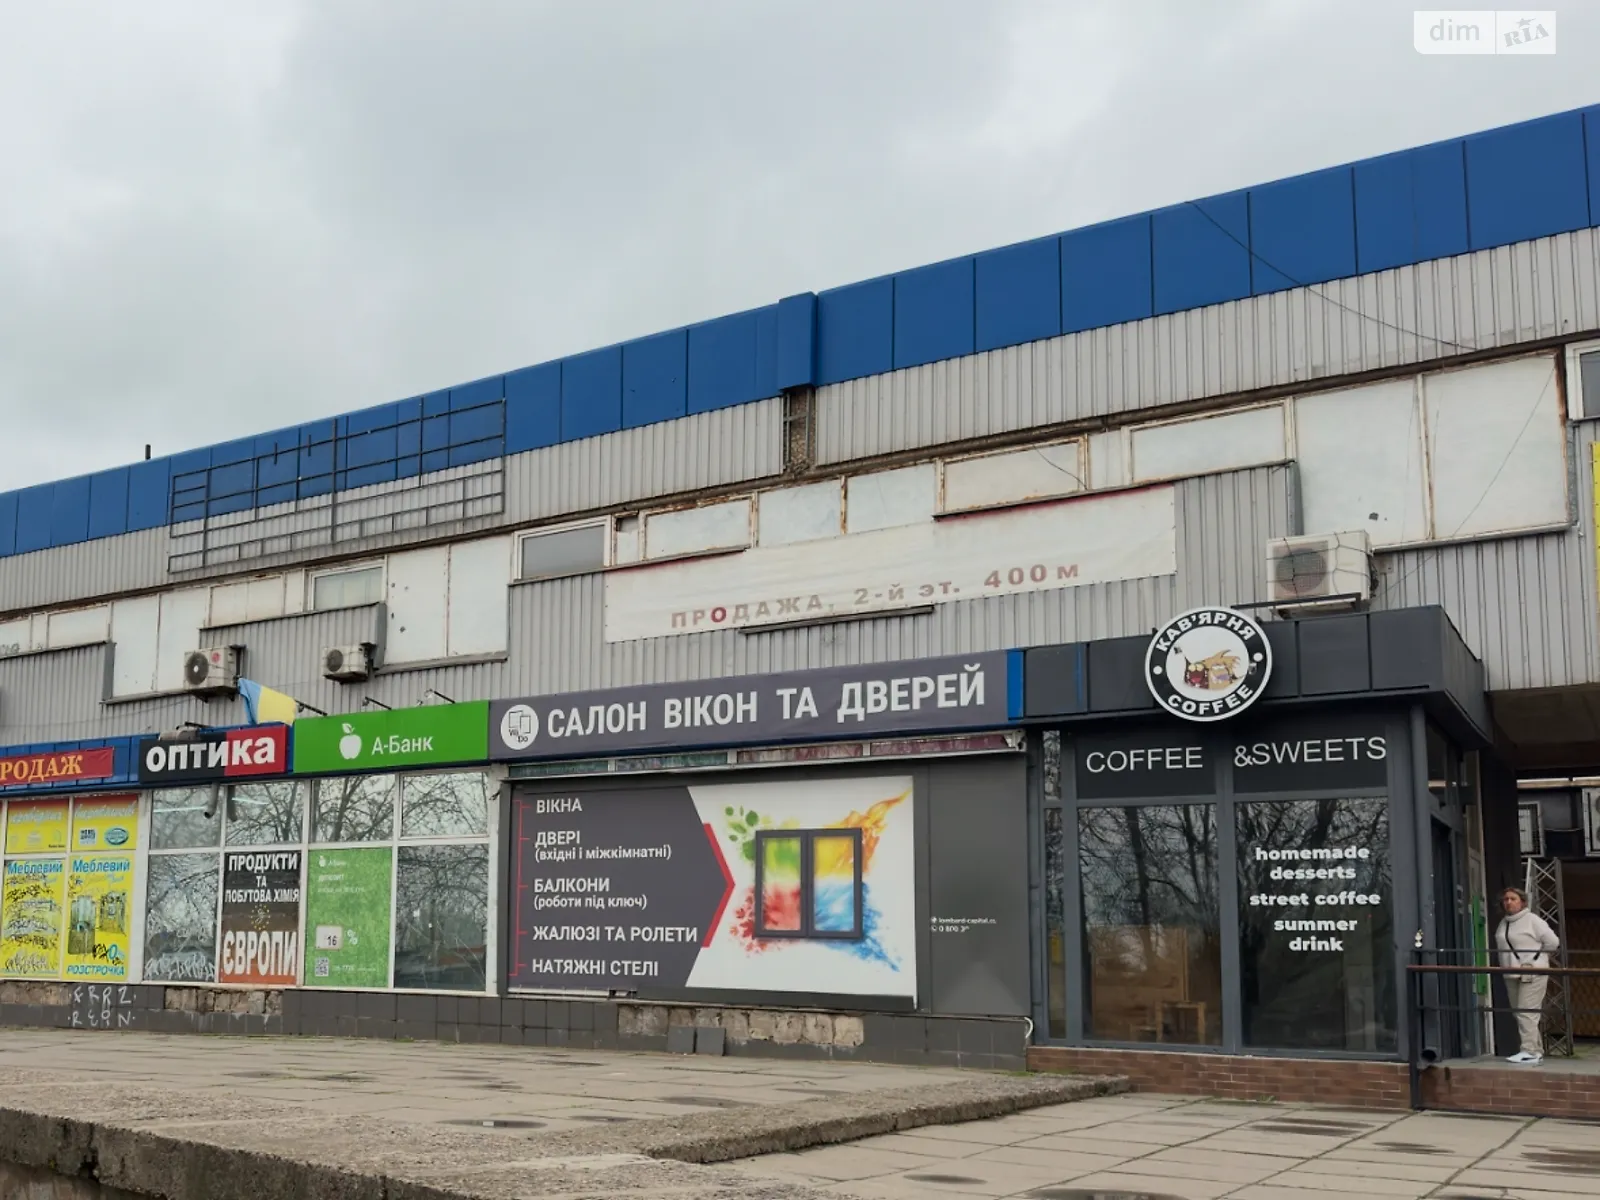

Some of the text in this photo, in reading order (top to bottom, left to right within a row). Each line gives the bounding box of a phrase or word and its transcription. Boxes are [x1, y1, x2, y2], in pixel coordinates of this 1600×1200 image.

[853, 581, 906, 606] 2-й
[918, 577, 961, 599] эт.
[547, 663, 987, 739] САЛОН ВІКОН ТА ДВЕРЕЙ
[1167, 683, 1254, 716] COFFEE
[145, 735, 276, 773] оптика
[371, 735, 433, 756] А-Банк
[1086, 735, 1388, 774] COFFEE &SWEETS
[536, 799, 583, 814] ВІКНА
[534, 831, 580, 848] ДВЕРІ
[534, 847, 577, 863] (вхідні
[585, 844, 672, 860] міжкімнатні)
[1254, 846, 1371, 861] homemade
[7, 859, 64, 876] Меблевий
[72, 858, 131, 873] Меблевий
[228, 853, 298, 874] ПРОДУКТИ
[255, 875, 267, 888] ТА
[1269, 865, 1357, 881] desserts
[533, 877, 610, 894] БАЛКОНИ
[225, 888, 300, 903] ПОБУТОВА ХІМІЯ
[533, 895, 648, 910] (роботи під ключ)
[1249, 891, 1382, 907] street coffee
[1273, 918, 1358, 932] summer
[532, 926, 698, 942] ЖАЛЮЗІ ТА РОЛЕТИ
[1288, 936, 1344, 952] drink
[223, 930, 297, 977] ЄВРОПИ
[532, 959, 659, 976] НАТЯЖНІ СТЕЛІ
